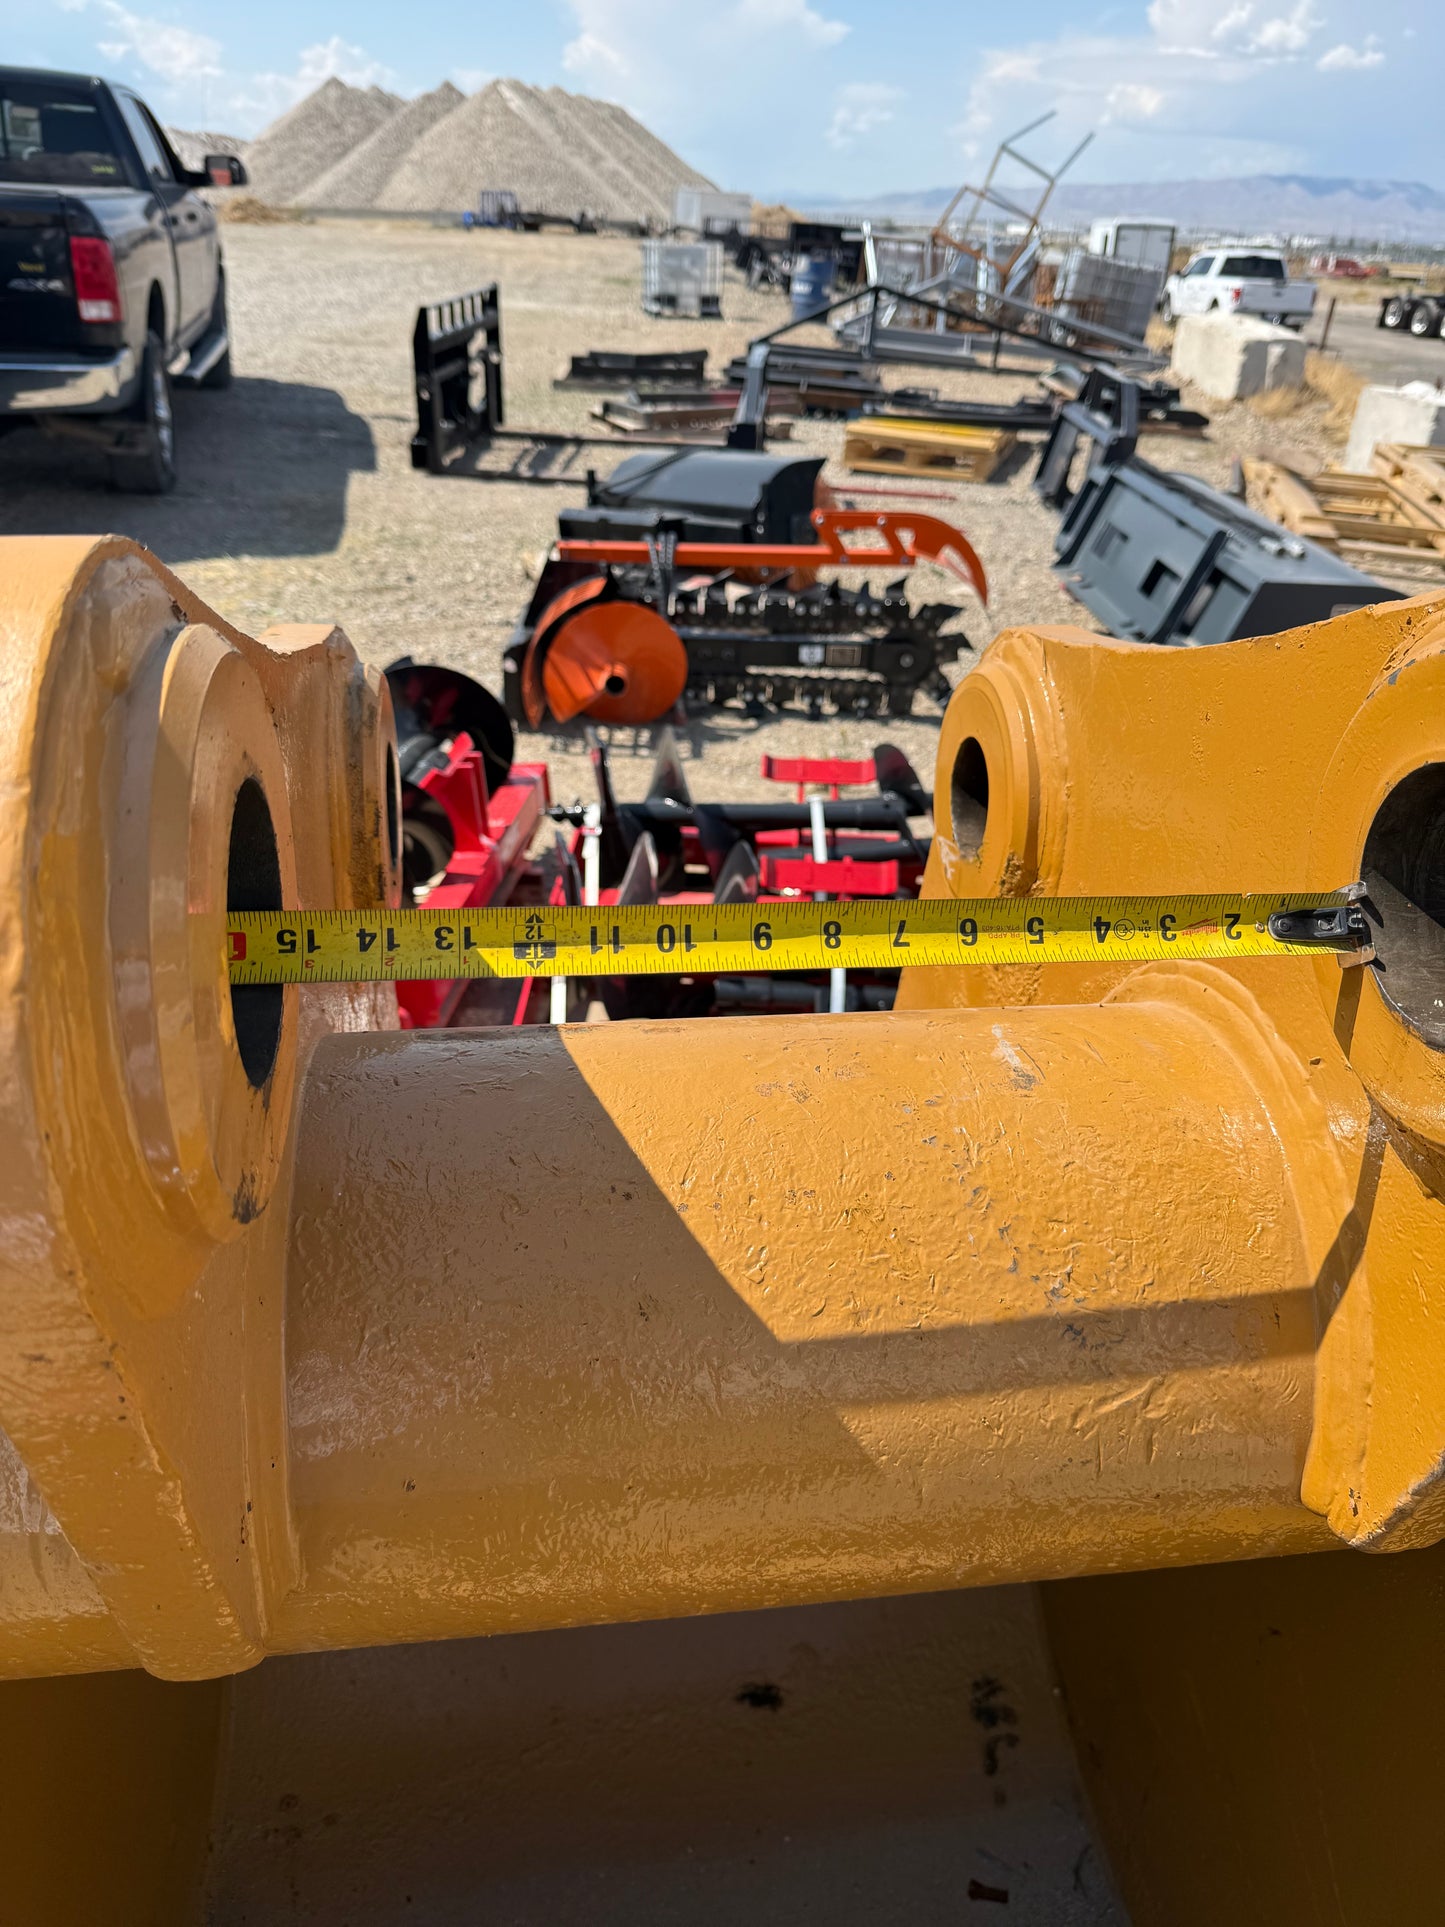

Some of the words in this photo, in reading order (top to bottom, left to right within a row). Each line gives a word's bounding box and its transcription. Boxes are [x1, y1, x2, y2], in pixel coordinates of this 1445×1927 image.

[356, 927, 401, 952] 14
[434, 926, 477, 951] 13
[525, 926, 545, 940] 12
[590, 925, 625, 955] 11
[656, 924, 697, 953] 10
[753, 922, 773, 951] 9
[823, 920, 842, 949] 8
[892, 920, 911, 948] 7
[960, 918, 978, 946] 6
[1027, 917, 1044, 944] 5
[1093, 916, 1111, 943] 4
[1160, 914, 1177, 941] 3
[1181, 921, 1219, 937] Milwaukee
[1224, 913, 1242, 940] 2
[276, 929, 321, 954] 15
[525, 943, 545, 958] 1F
[304, 959, 315, 969] 3
[384, 956, 395, 967] 2
[463, 956, 469, 965] 1
